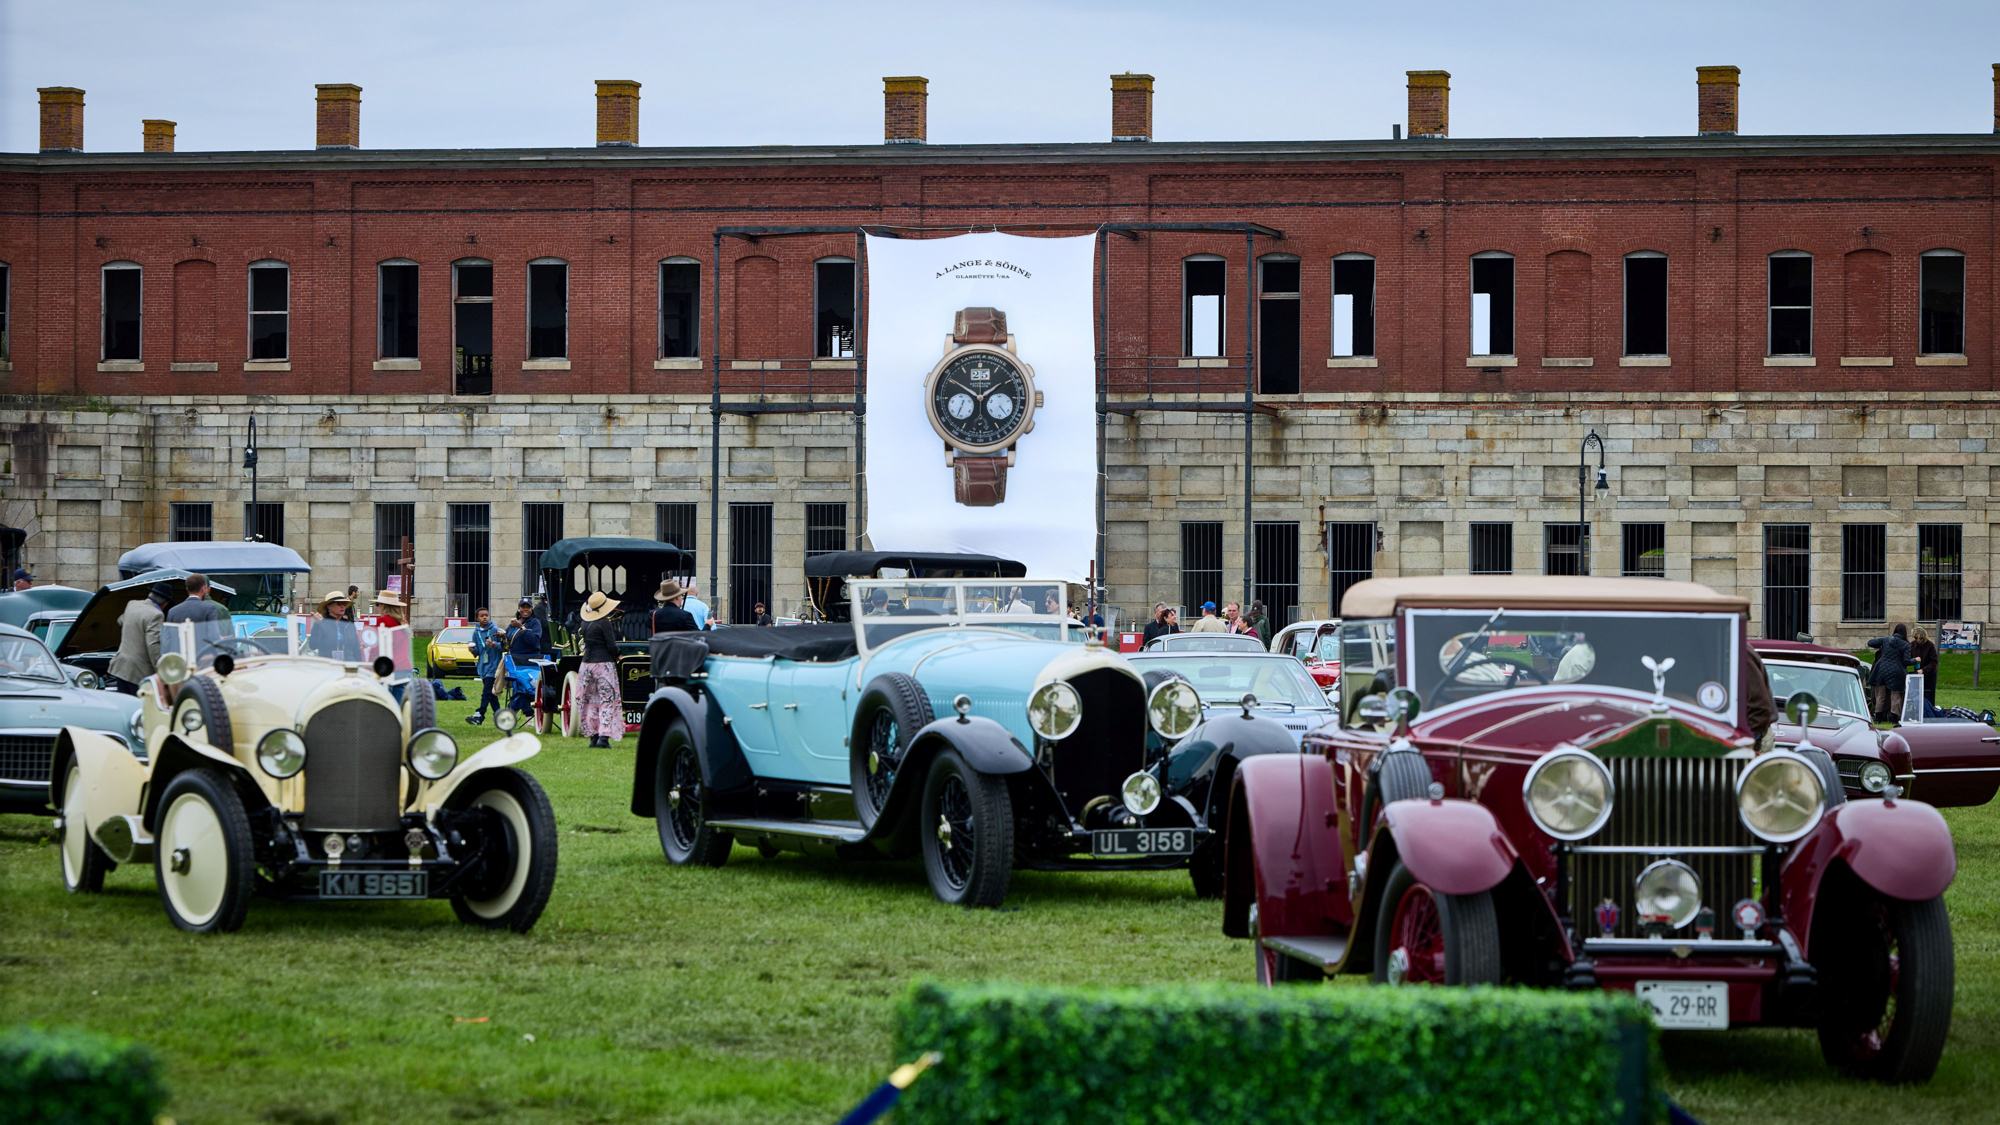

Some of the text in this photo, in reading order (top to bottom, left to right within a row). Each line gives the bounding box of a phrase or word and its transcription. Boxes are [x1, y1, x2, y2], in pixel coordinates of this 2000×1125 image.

[984, 259, 993, 267] &
[995, 260, 1032, 279] SÖHNE
[972, 371, 988, 379] 25
[1100, 831, 1186, 853] UL 3158
[325, 874, 423, 895] KM 9651
